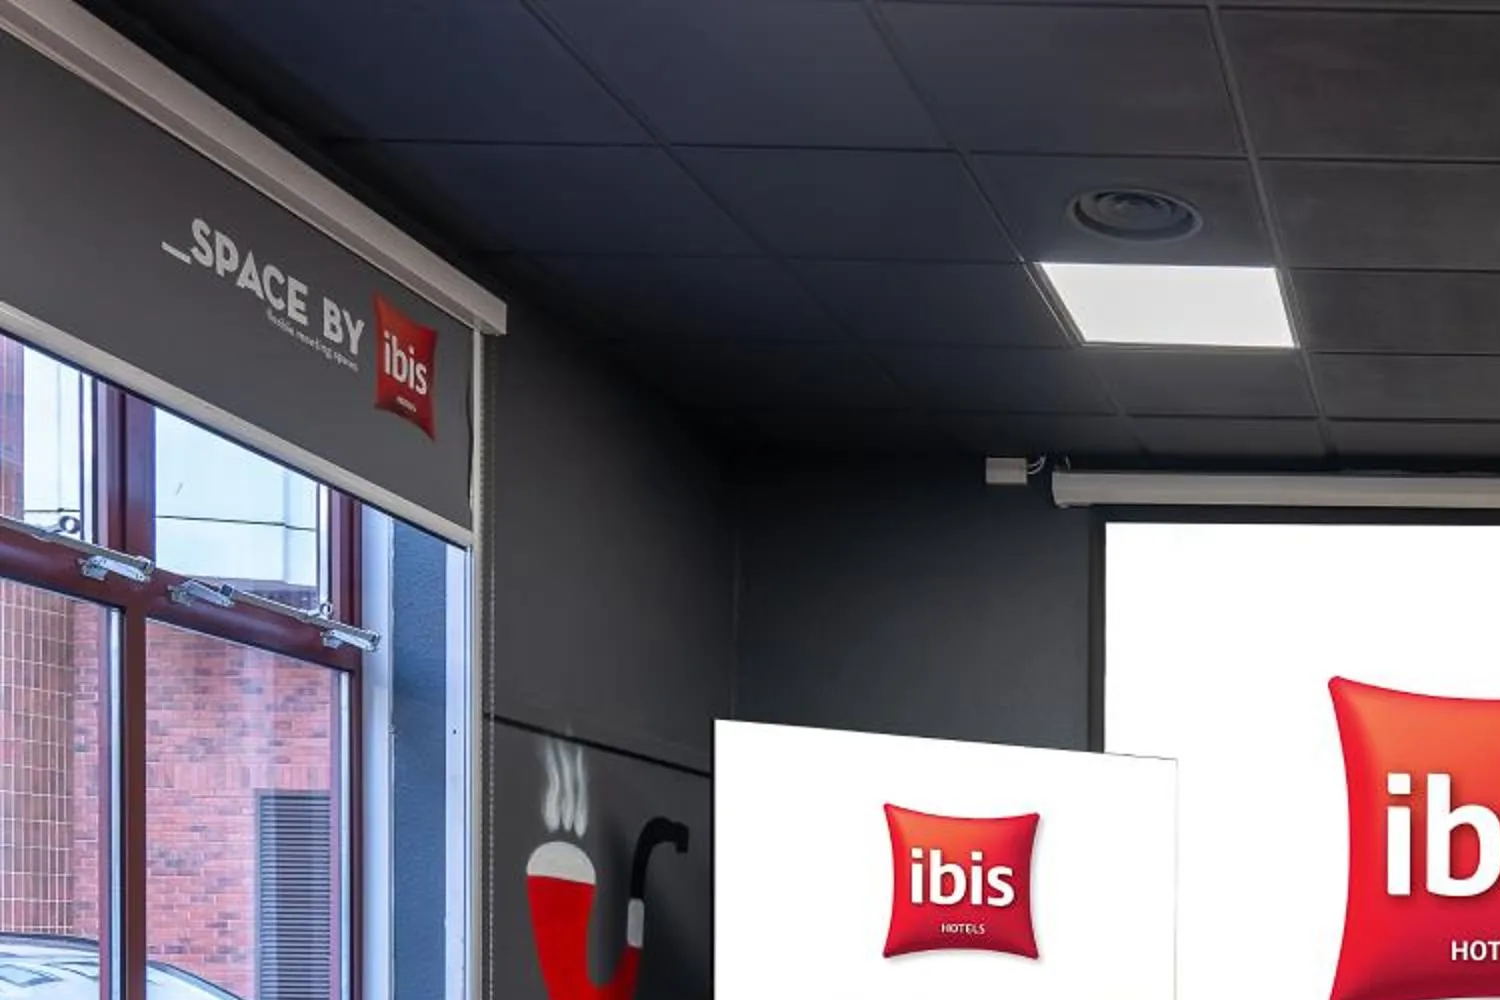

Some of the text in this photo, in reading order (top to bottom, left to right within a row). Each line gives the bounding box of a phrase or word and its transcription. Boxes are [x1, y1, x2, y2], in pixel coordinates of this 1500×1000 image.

[323, 297, 364, 355] BY
[383, 330, 427, 395] ibis
[911, 848, 1015, 907] ibis
[941, 923, 985, 935] HOTELS
